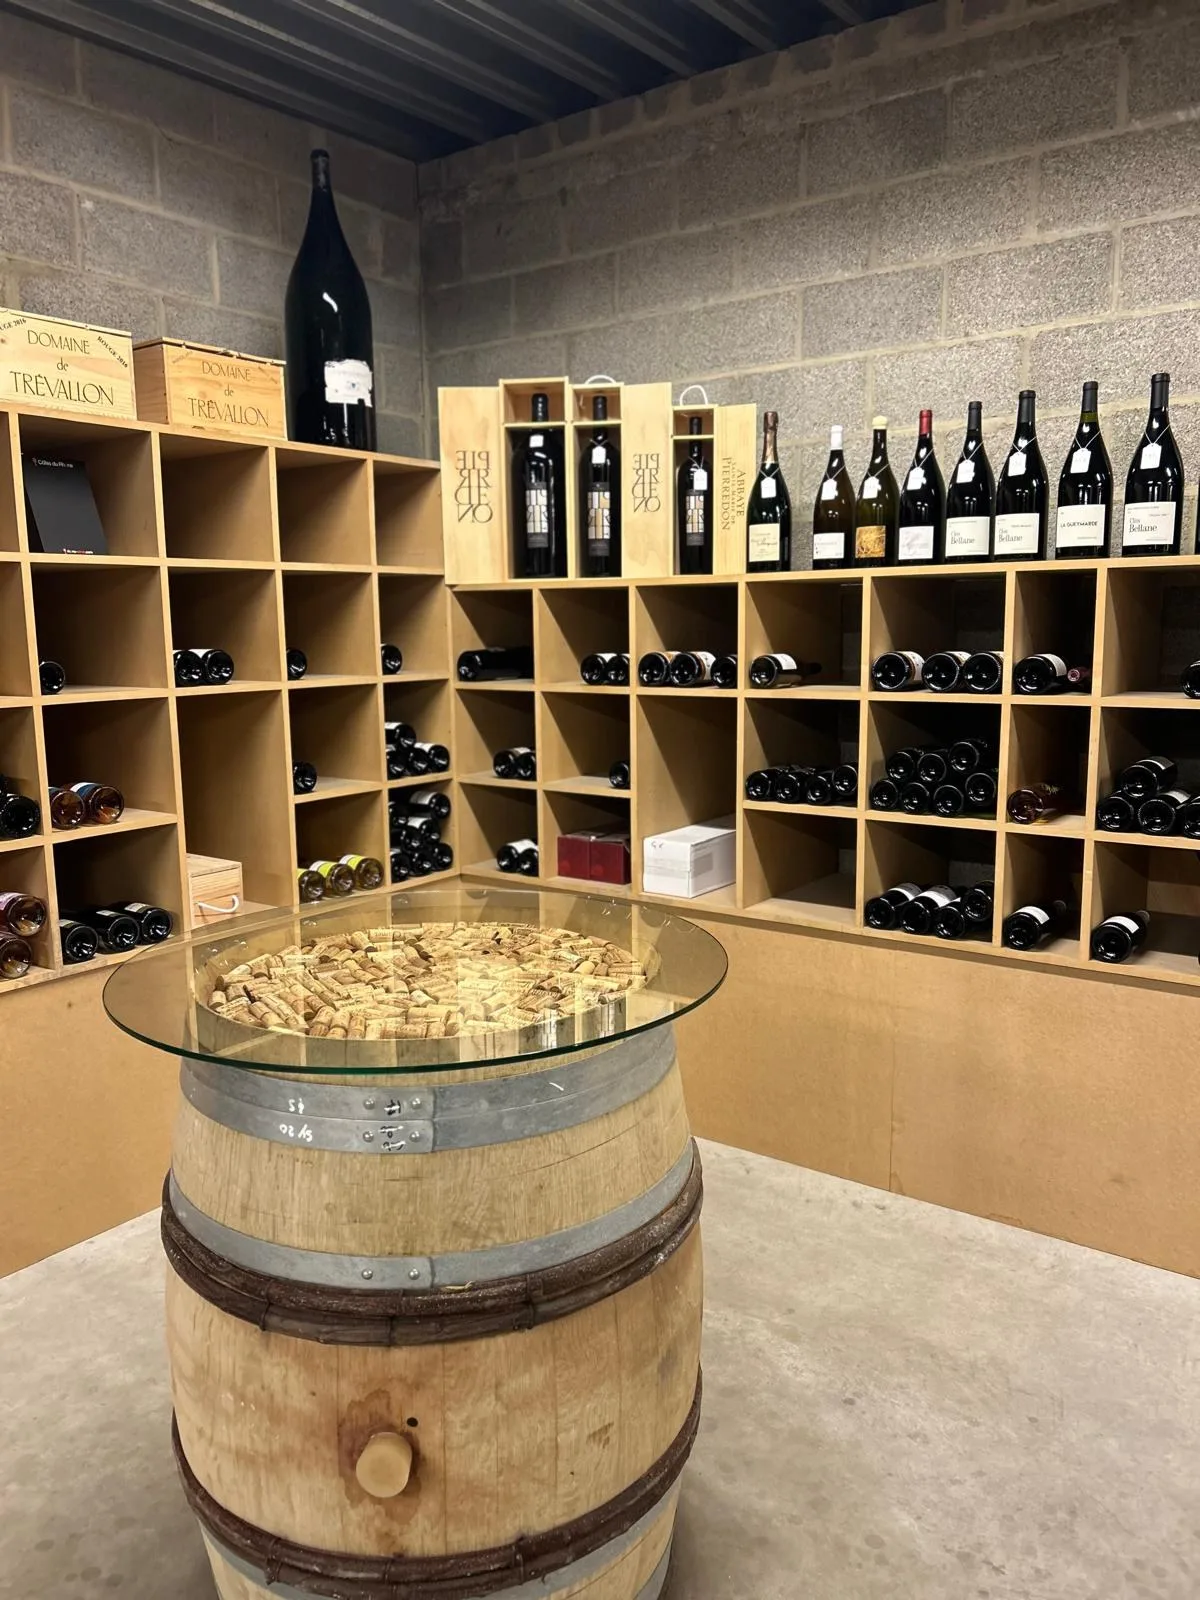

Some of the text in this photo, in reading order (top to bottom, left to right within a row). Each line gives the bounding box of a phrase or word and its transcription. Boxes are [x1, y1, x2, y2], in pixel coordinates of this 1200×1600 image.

[27, 329, 90, 355] DOMAINE
[97, 335, 129, 369] ROUGE 2016
[56, 356, 69, 372] de
[202, 360, 252, 382] DOMAINE
[9, 370, 114, 406] TRÉVALLON
[224, 382, 235, 397] de
[721, 456, 732, 531] PIERREDON
[736, 468, 747, 518] ABBAYE
[998, 534, 1023, 543] Bellane
[1129, 523, 1158, 533] Bellane
[950, 536, 975, 545] Bellane
